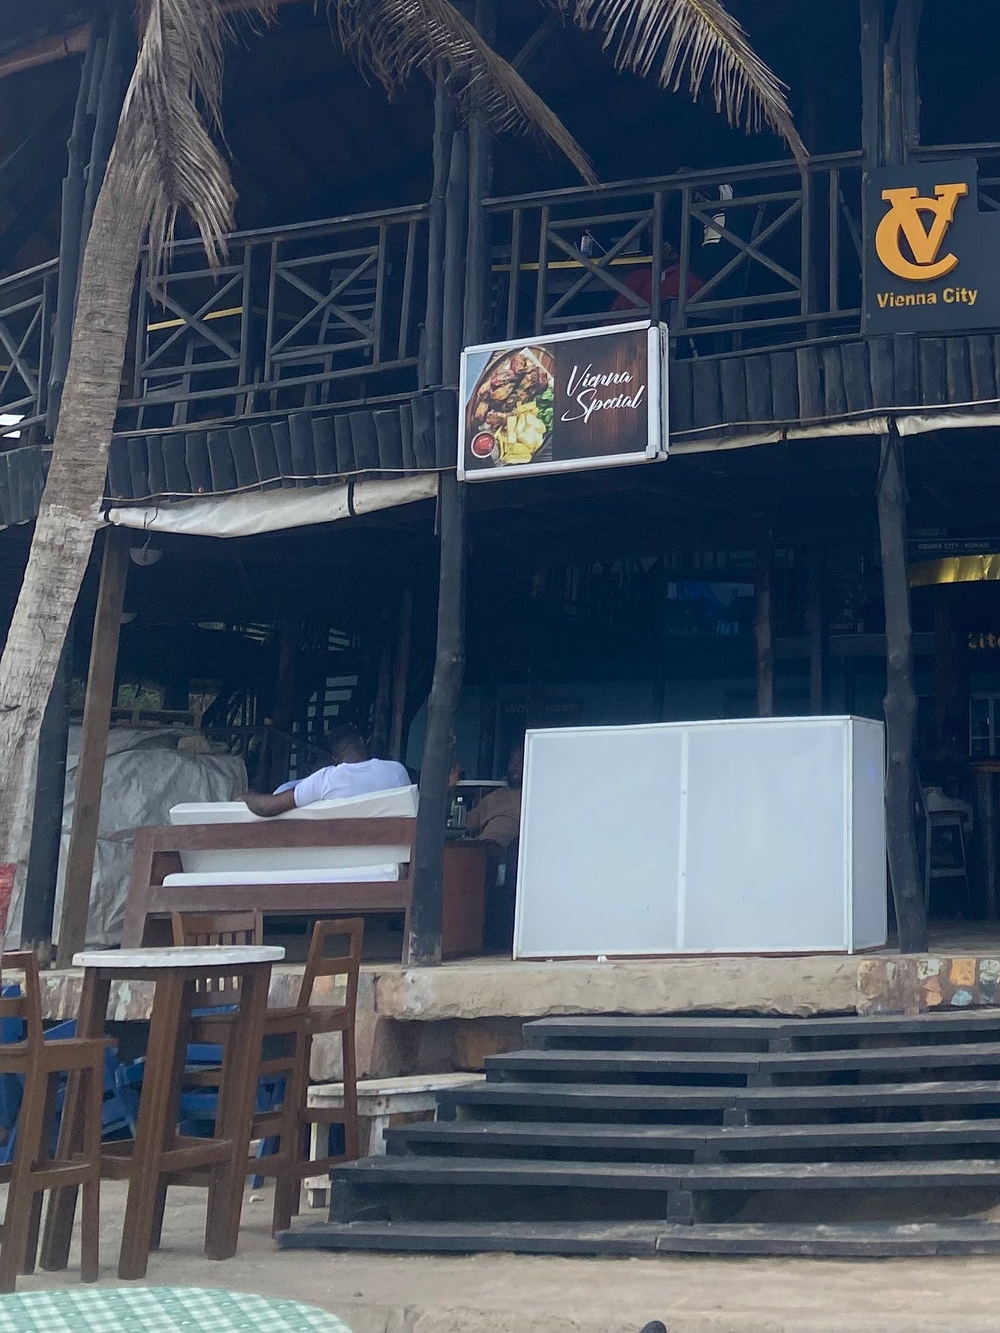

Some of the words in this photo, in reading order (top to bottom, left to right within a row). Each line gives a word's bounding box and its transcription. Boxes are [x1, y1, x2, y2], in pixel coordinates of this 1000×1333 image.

[877, 292, 937, 308] Vienna
[943, 287, 978, 305] City
[566, 364, 634, 397] Vienna
[560, 385, 645, 424] Special
